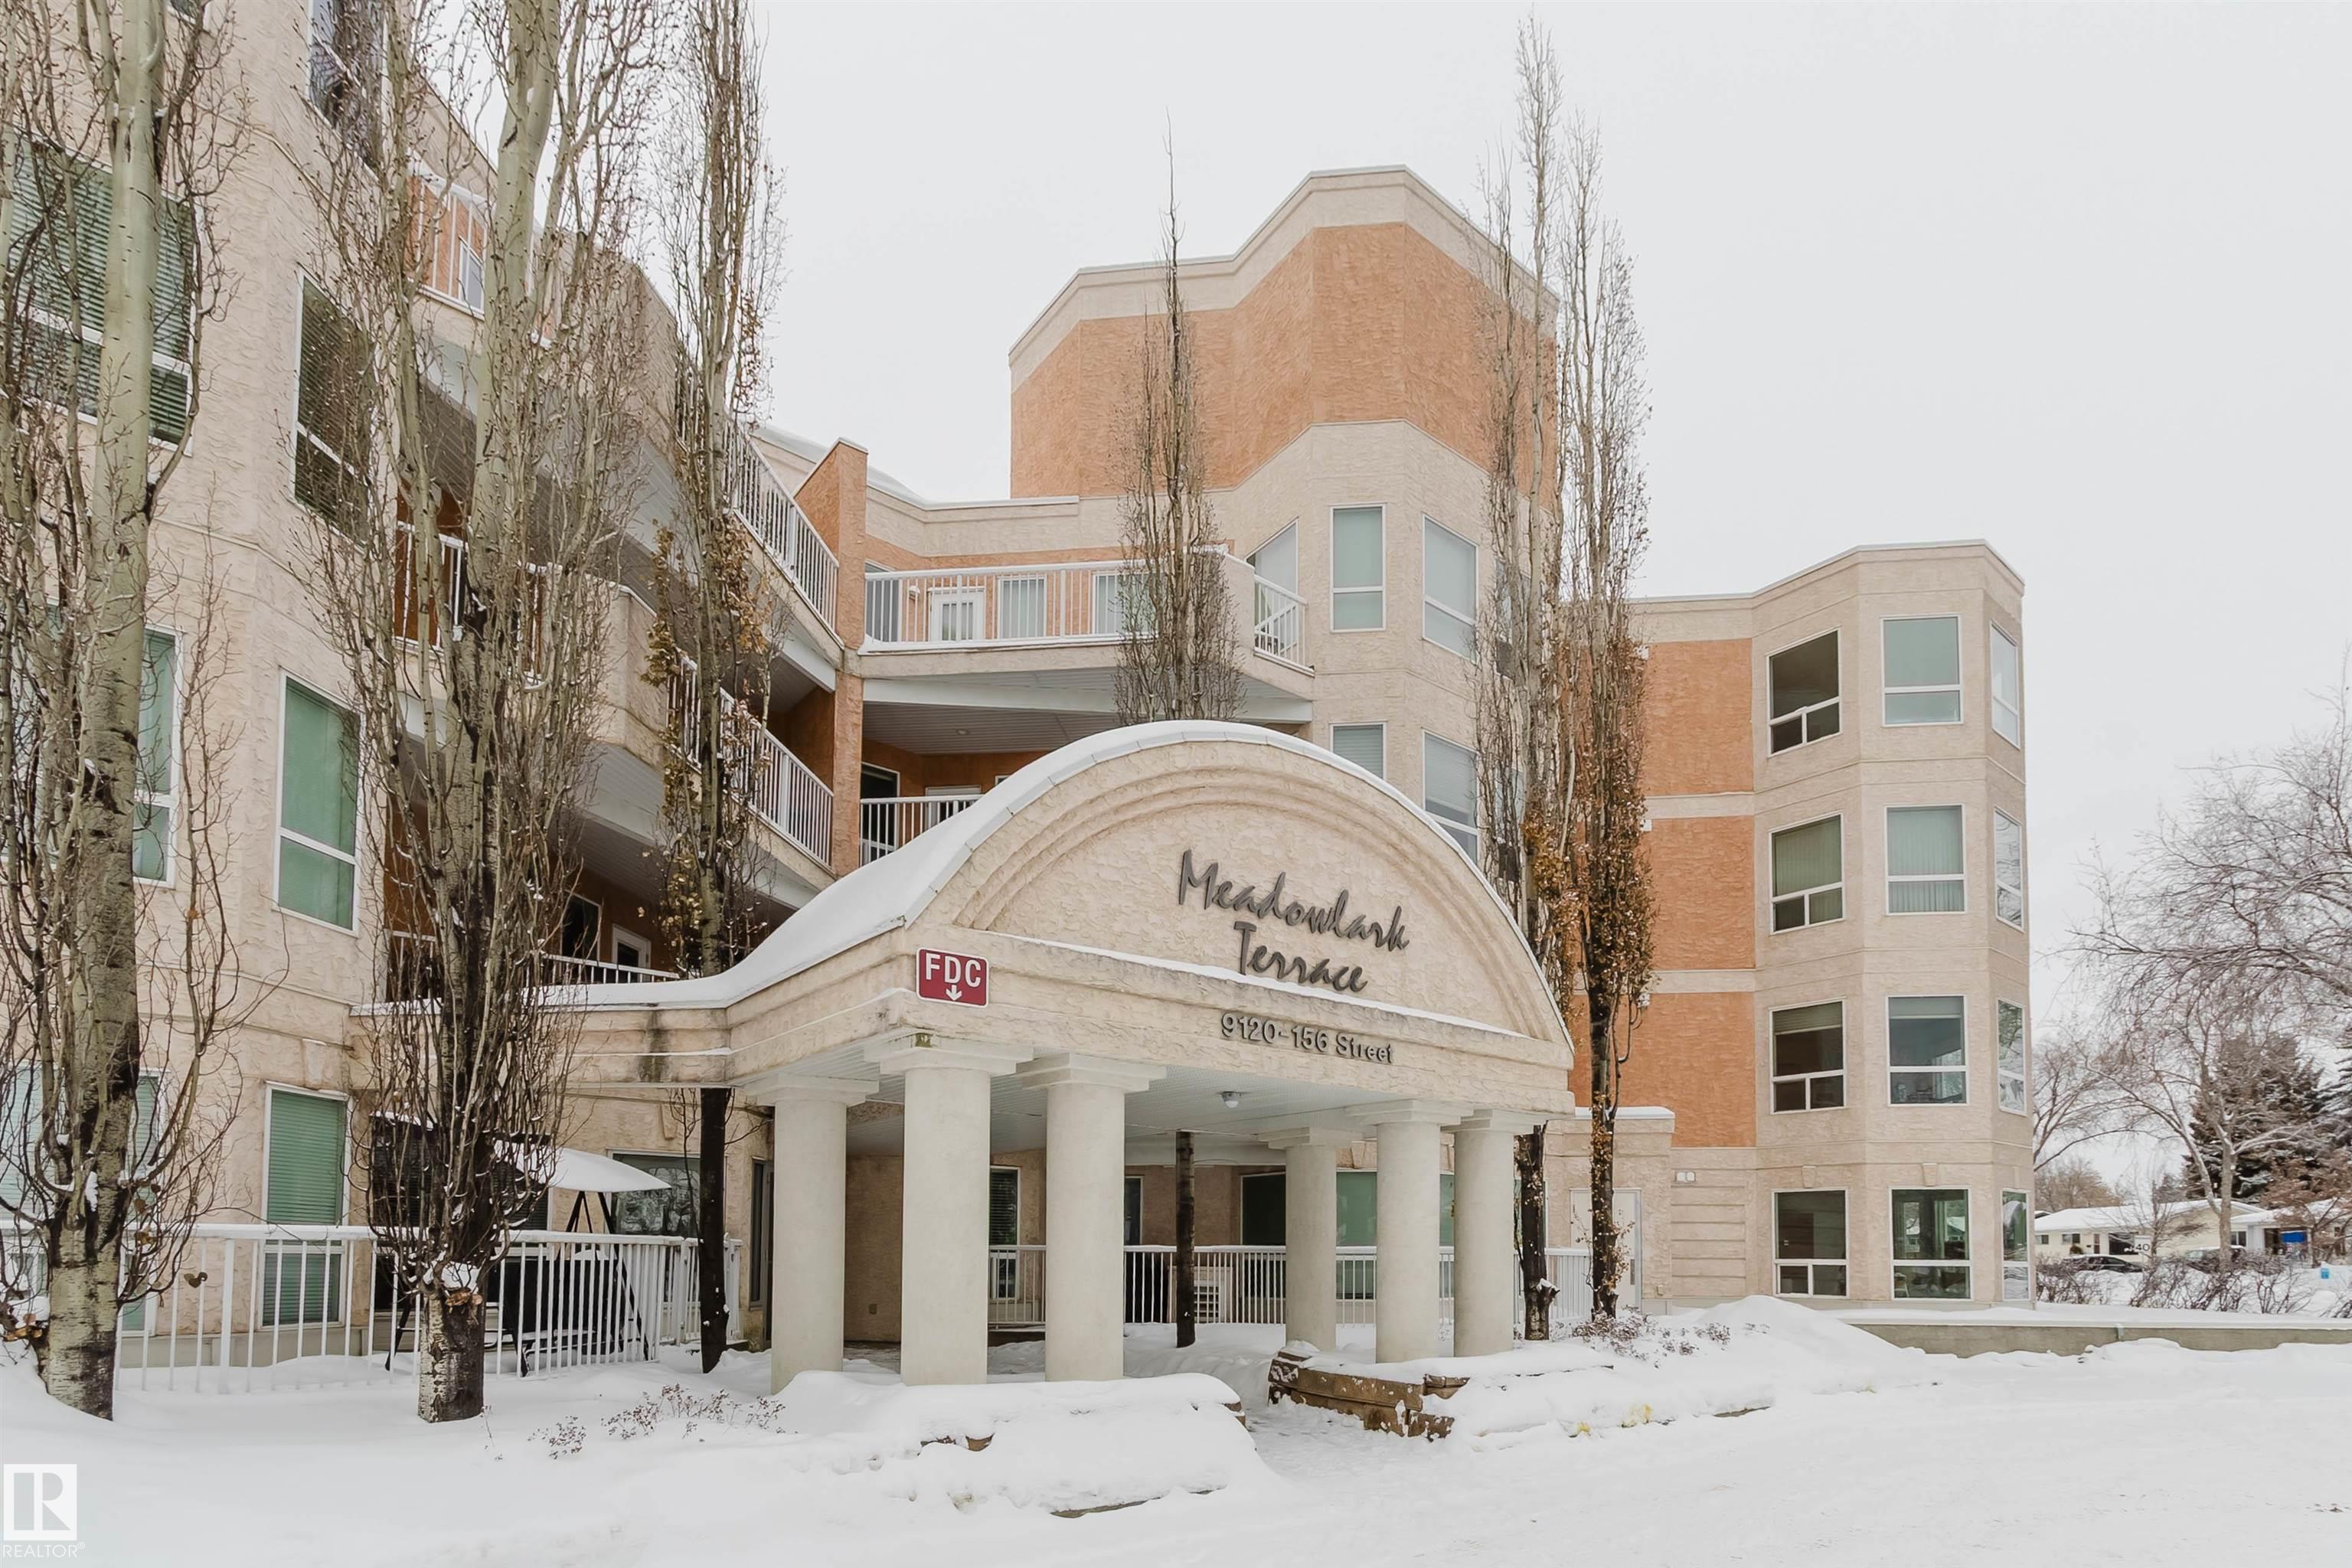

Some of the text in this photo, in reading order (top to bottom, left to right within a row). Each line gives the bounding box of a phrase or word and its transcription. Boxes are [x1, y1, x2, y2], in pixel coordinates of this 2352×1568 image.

[1178, 849, 1410, 952] Meadowlark
[926, 952, 981, 988] FDC
[1233, 920, 1368, 992] Terrace
[1336, 1032, 1393, 1063] Street
